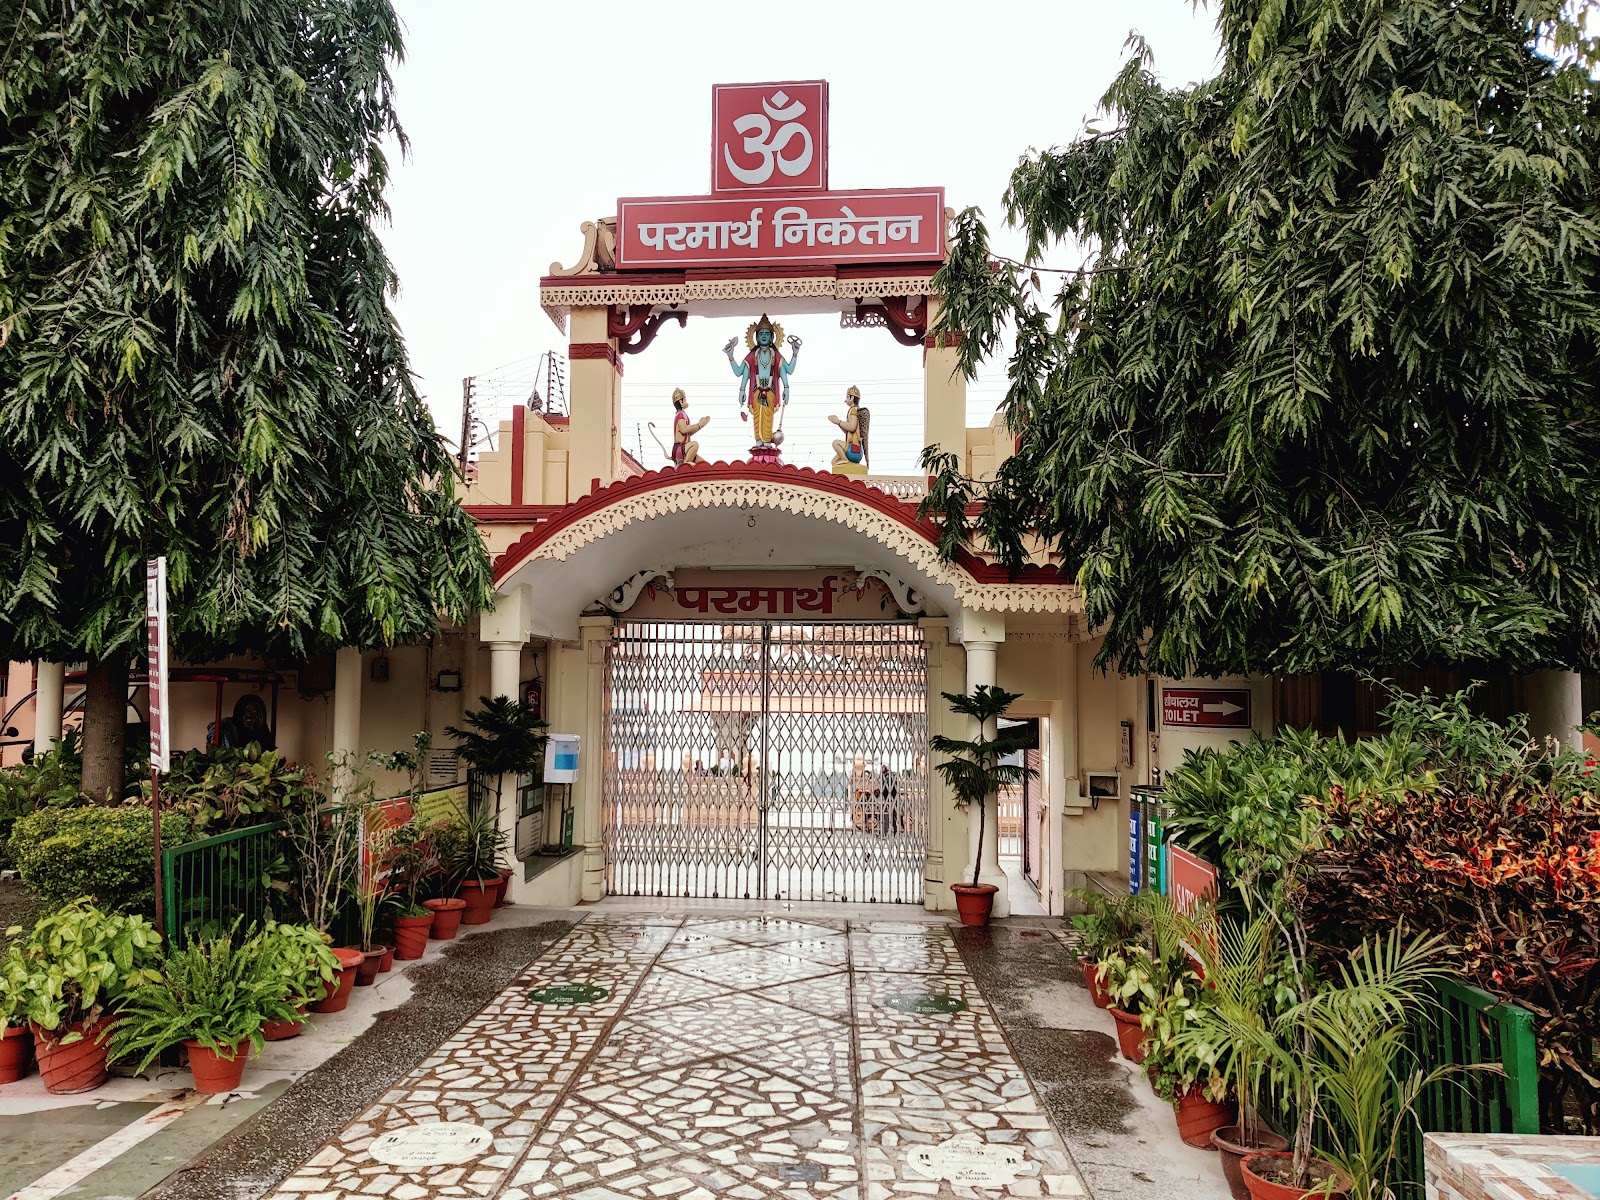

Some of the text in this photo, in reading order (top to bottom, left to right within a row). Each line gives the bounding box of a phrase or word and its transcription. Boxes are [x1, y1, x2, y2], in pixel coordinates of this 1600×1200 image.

[637, 205, 923, 251] परमार्थ निकेतन
[673, 575, 839, 614] परमार्थ
[1164, 709, 1200, 722] TOILET
